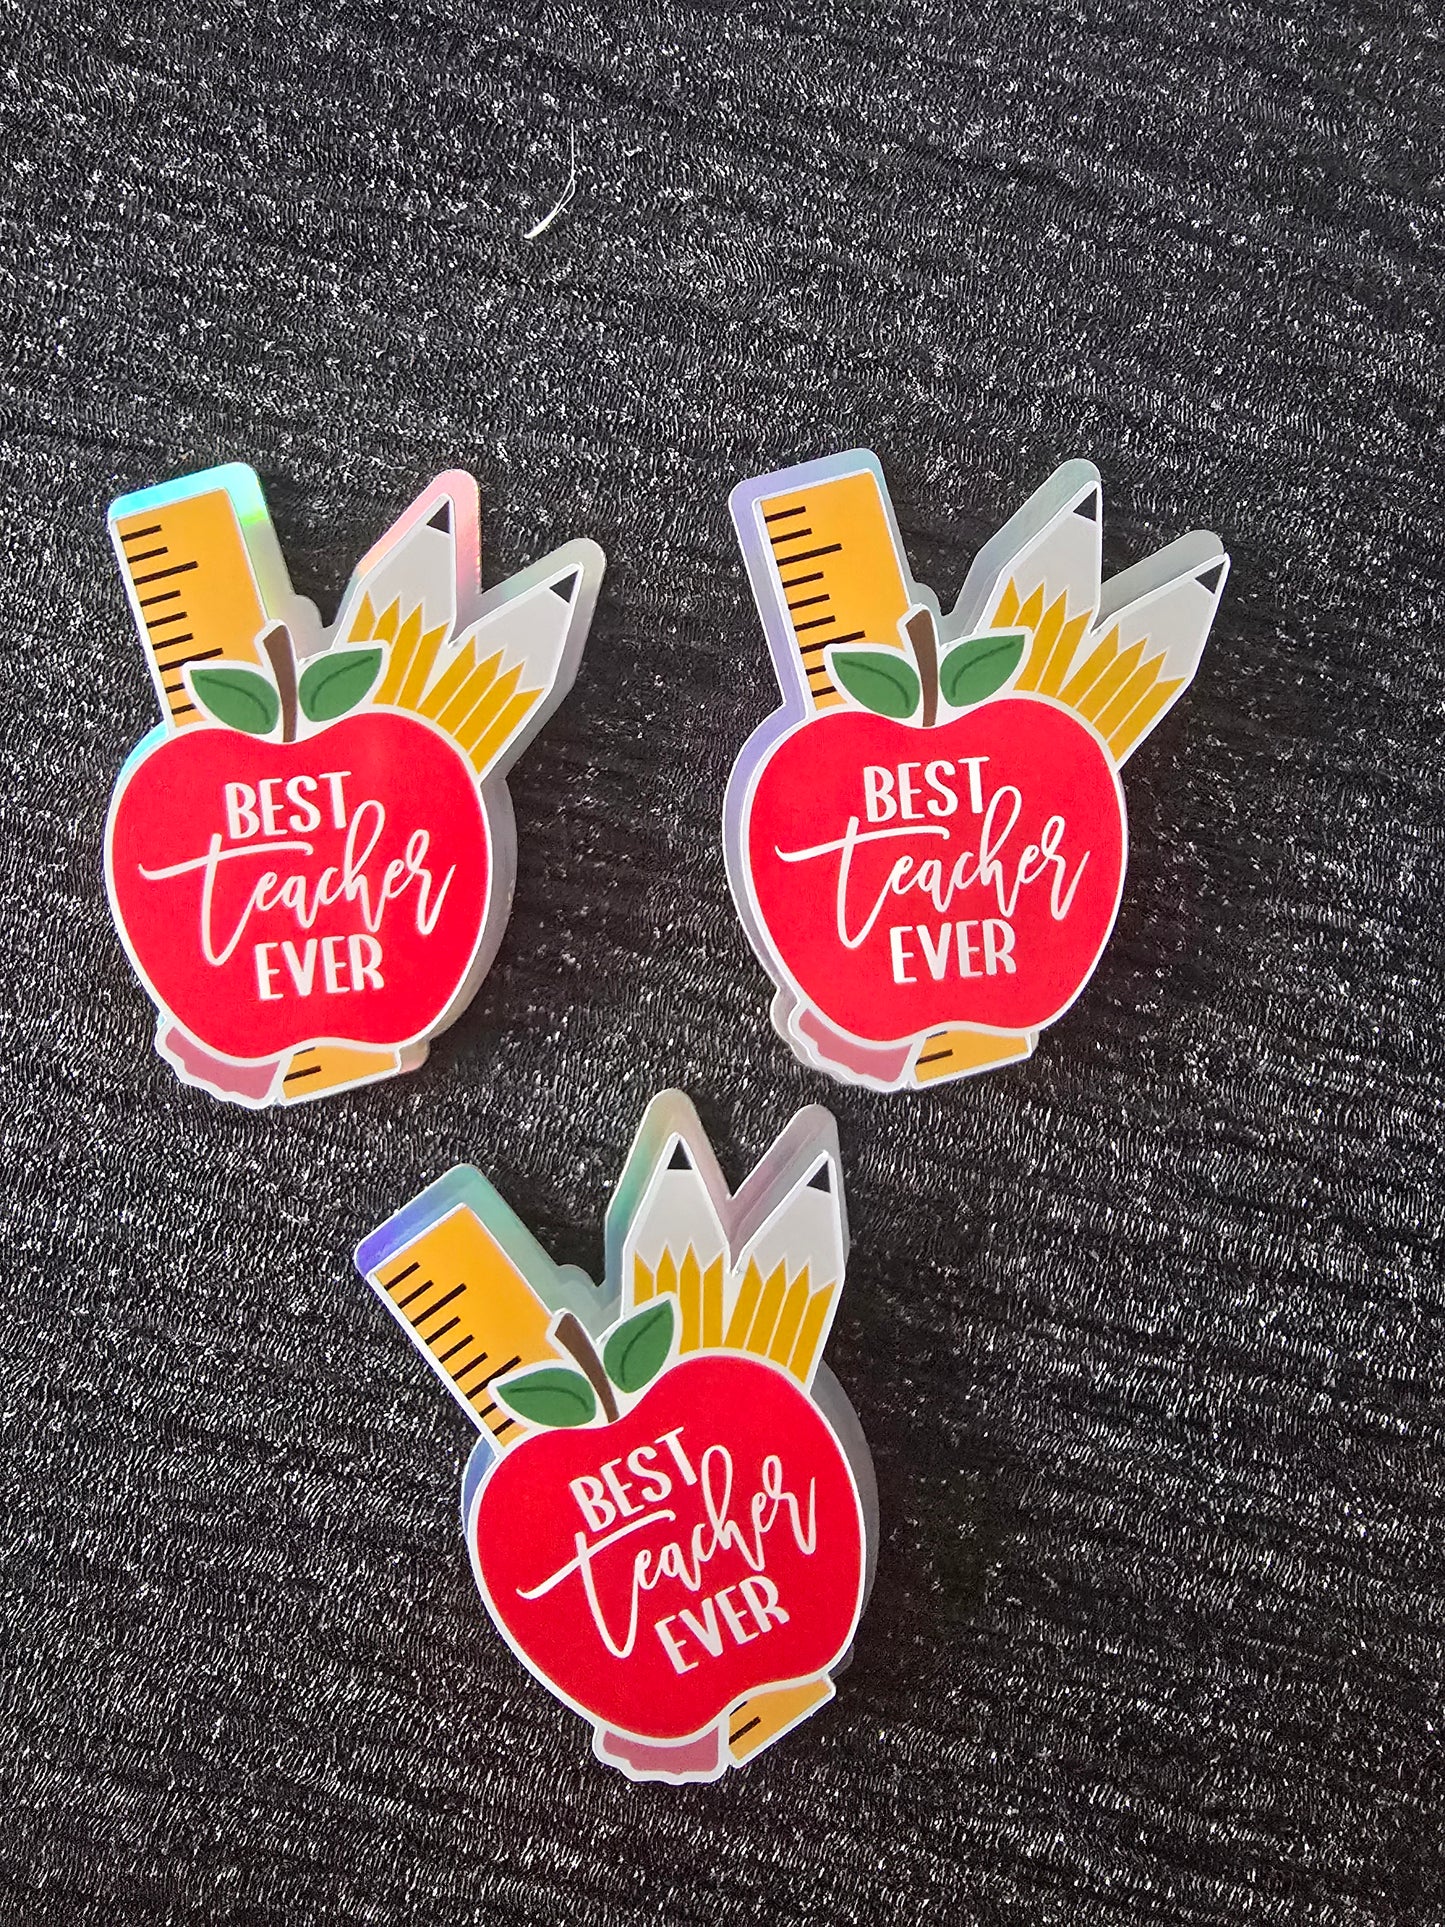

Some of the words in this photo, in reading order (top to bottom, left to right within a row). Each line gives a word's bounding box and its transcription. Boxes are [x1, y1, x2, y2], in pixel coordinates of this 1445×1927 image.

[224, 770, 352, 840] BEST
[863, 755, 991, 823] BEST
[254, 933, 385, 1001] EVER
[889, 918, 1017, 985] EVER
[568, 1426, 698, 1533] BEST
[654, 1575, 790, 1675] EVER
